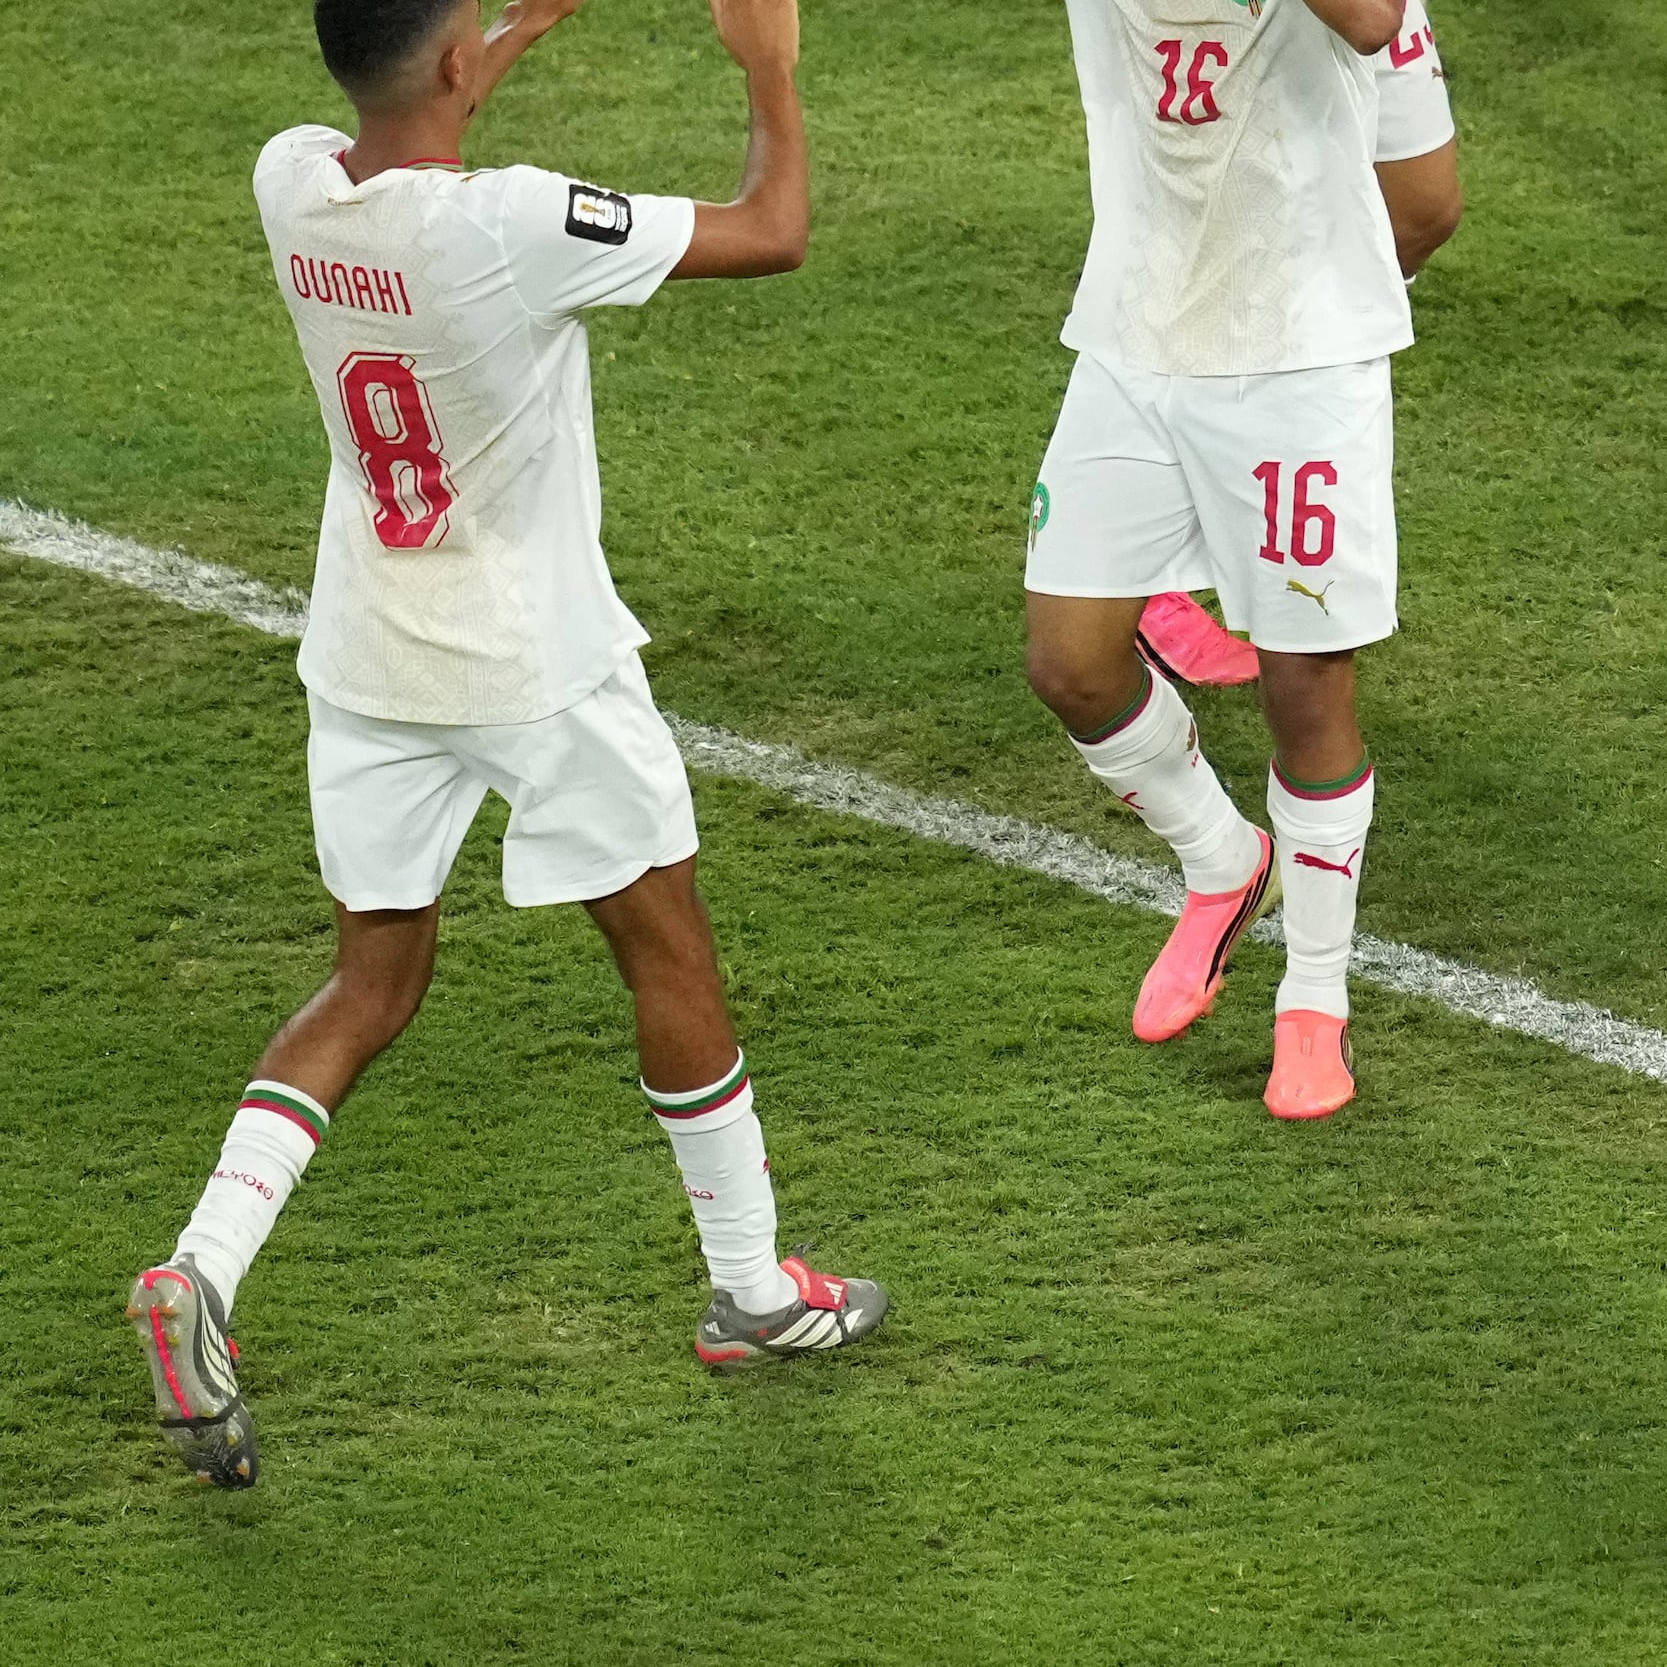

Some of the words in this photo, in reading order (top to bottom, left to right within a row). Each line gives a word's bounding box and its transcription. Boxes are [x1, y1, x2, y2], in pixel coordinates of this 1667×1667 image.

[1155, 39, 1228, 126] 16
[289, 253, 415, 318] OUNAHI
[335, 350, 460, 553] 8
[1251, 459, 1339, 567] 16
